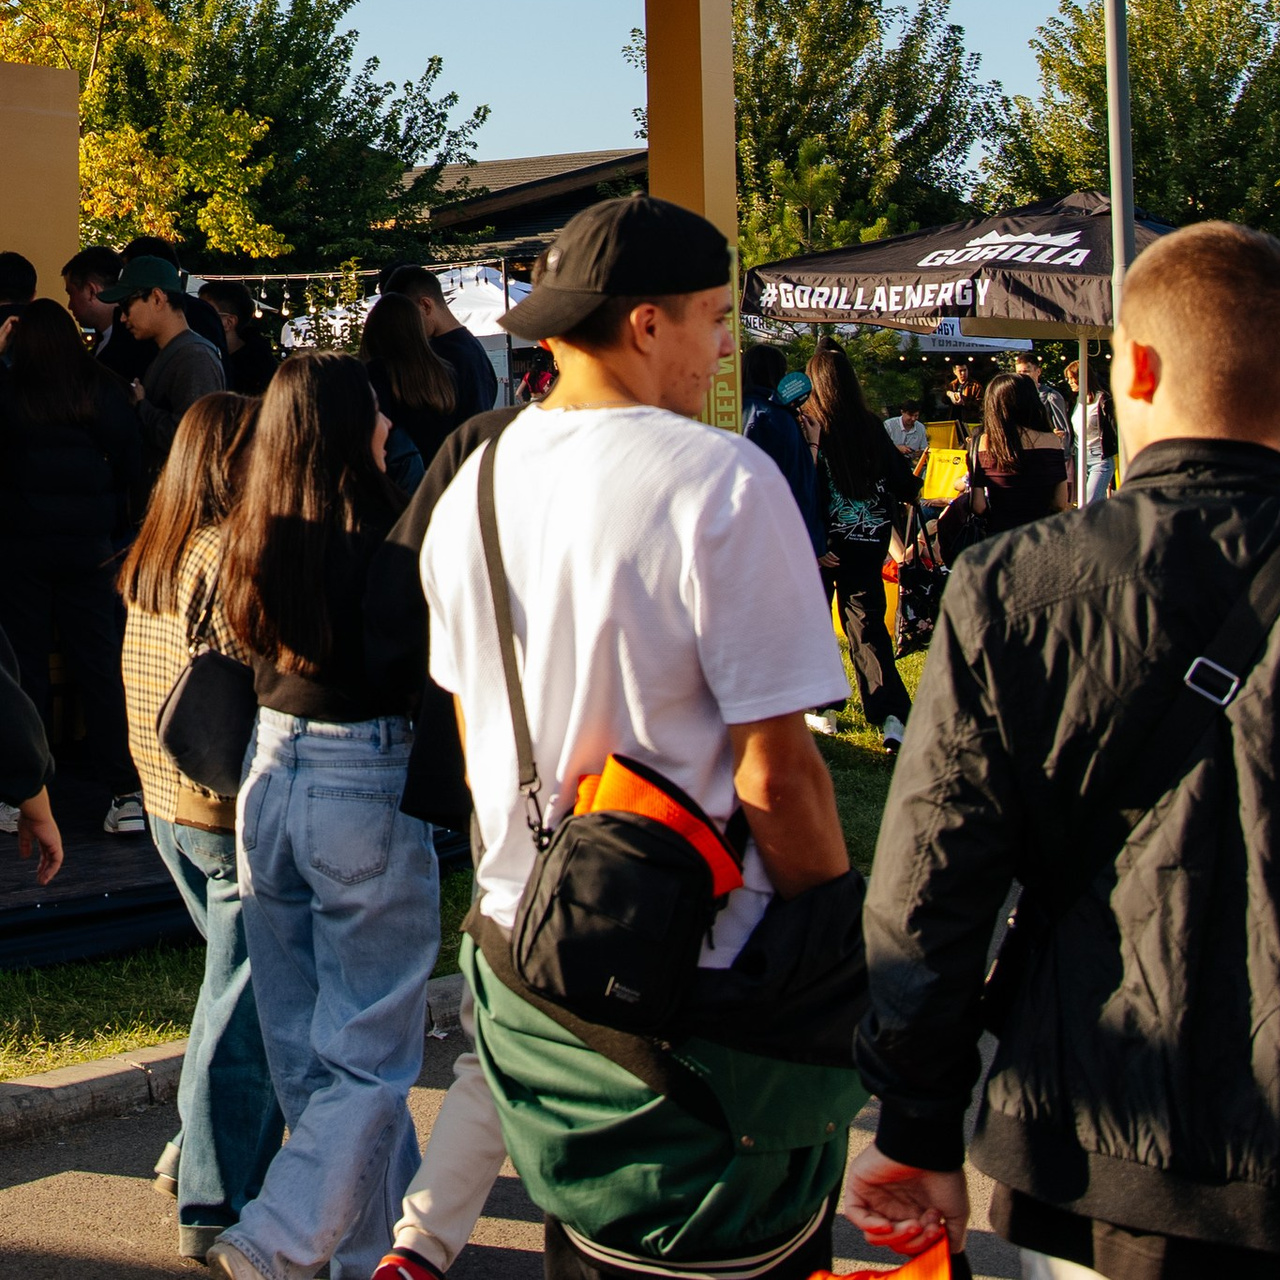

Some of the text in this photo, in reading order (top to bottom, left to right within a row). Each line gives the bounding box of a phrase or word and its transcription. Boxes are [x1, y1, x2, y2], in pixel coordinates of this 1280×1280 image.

[917, 244, 1091, 267] GORILLA
[759, 278, 990, 312] #GORILLAENERGY
[716, 381, 736, 432] EEP
